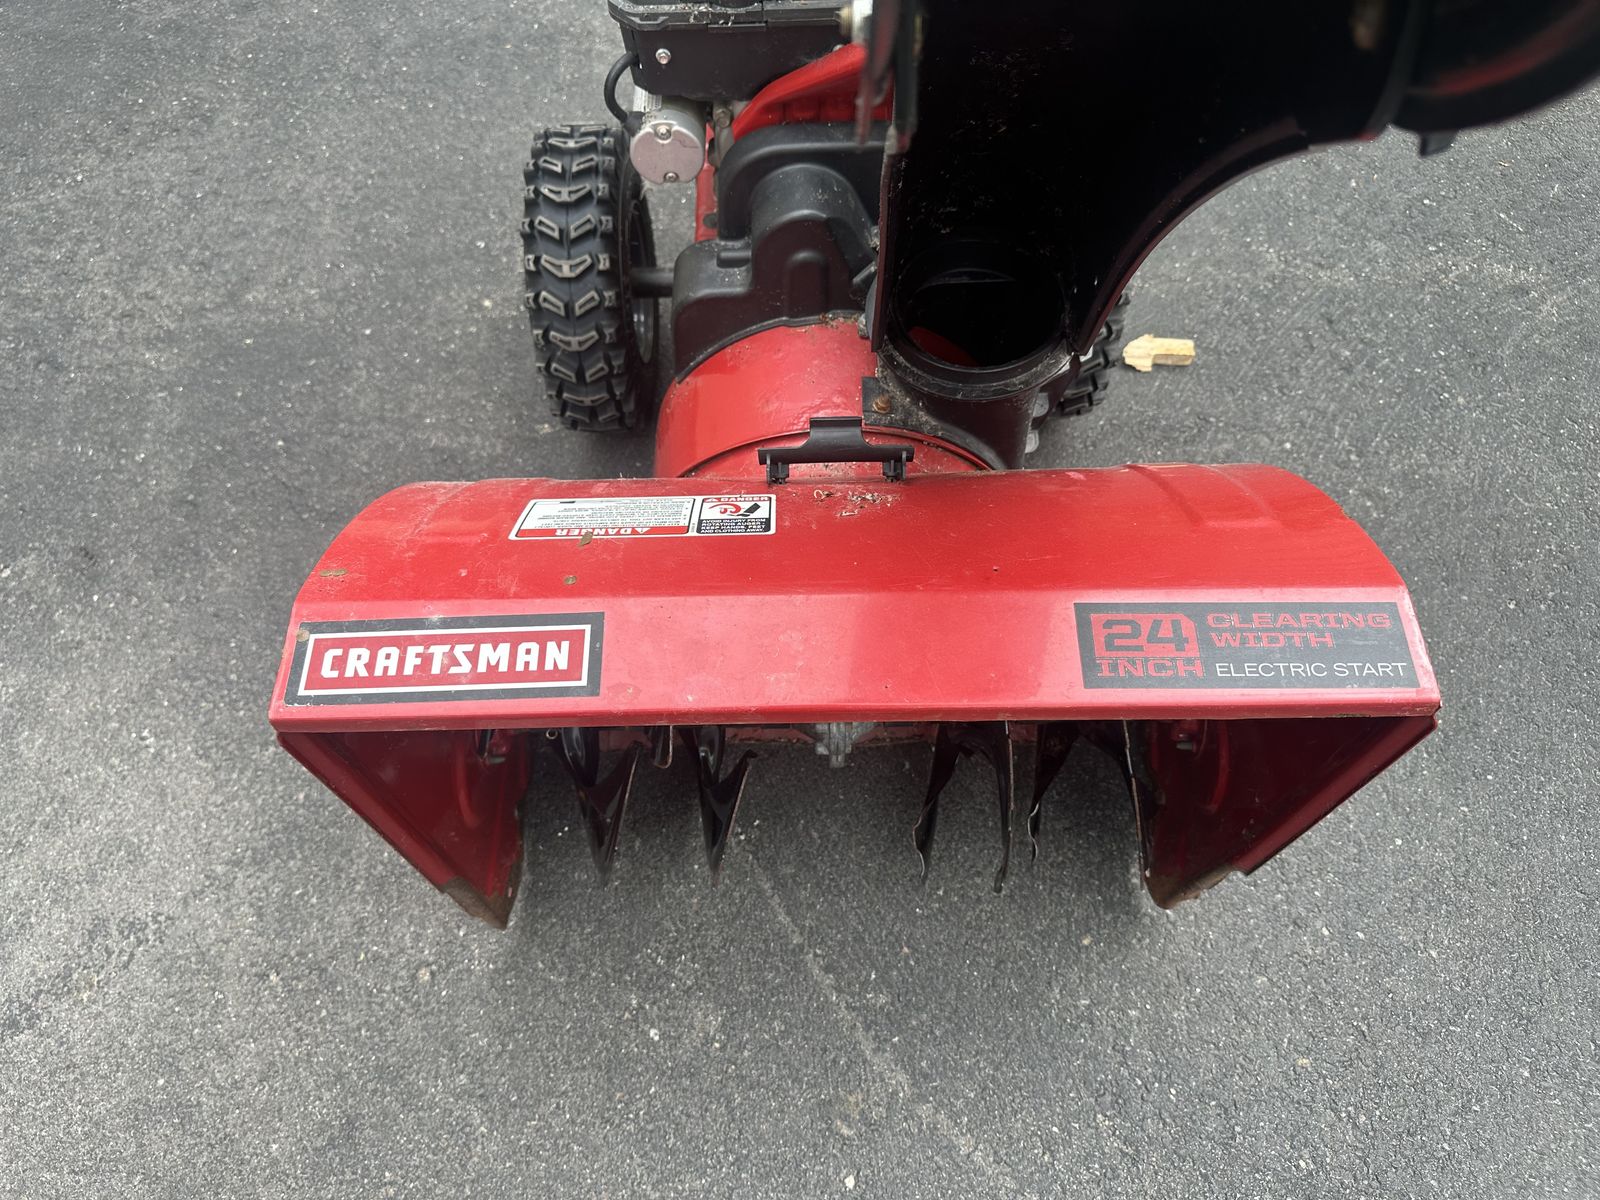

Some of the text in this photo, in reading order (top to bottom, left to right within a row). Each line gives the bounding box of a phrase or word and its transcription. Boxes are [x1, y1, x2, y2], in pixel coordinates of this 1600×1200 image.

[1206, 612, 1393, 629] CLEARING
[1102, 618, 1189, 652] 24
[1210, 632, 1335, 648] WIDTH
[320, 640, 570, 678] CRAFTSMAN
[1096, 658, 1204, 677] INCH
[1215, 662, 1407, 677] ELECTRIC START
